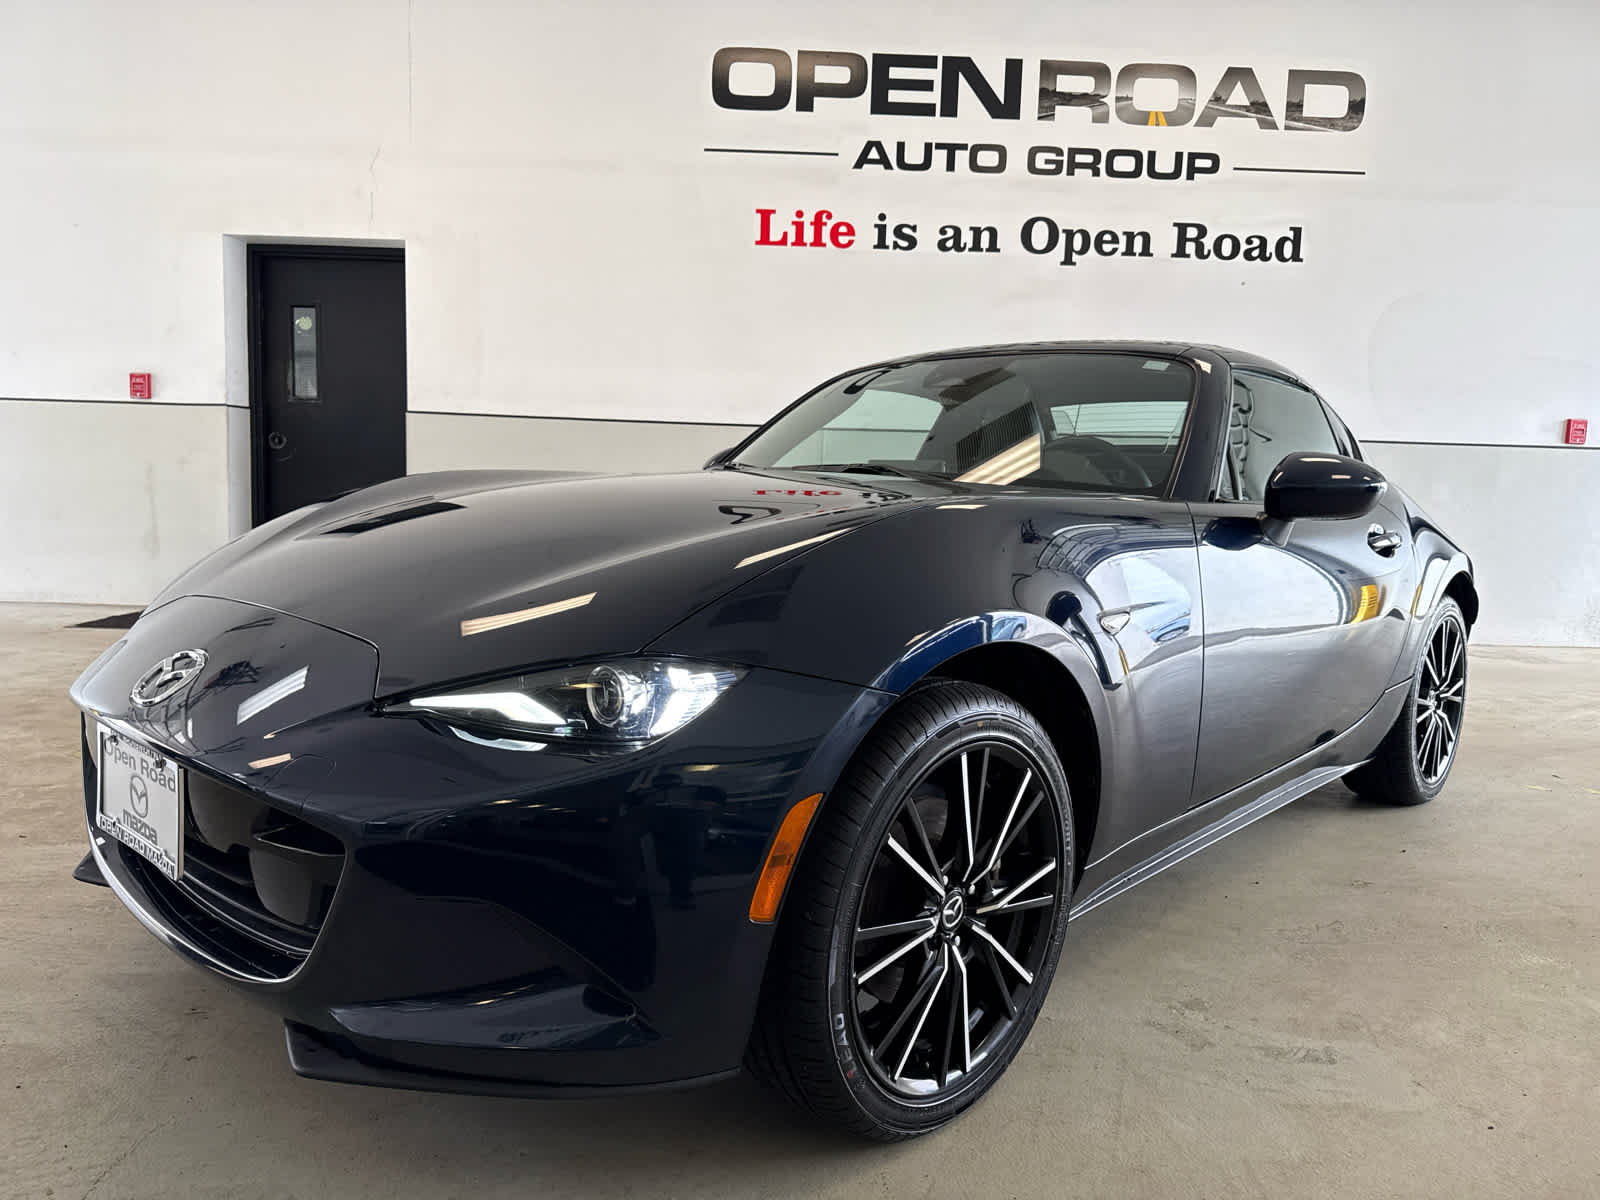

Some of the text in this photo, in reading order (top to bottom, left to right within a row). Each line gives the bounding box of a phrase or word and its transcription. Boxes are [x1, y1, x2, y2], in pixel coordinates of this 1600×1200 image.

[711, 46, 1367, 132] OPEN ROAD
[852, 140, 1221, 181] AUTO GROUP
[754, 208, 1304, 266] Life is an Open Road
[104, 736, 136, 771] Open
[141, 757, 176, 793] Road
[124, 832, 147, 854] ROAD
